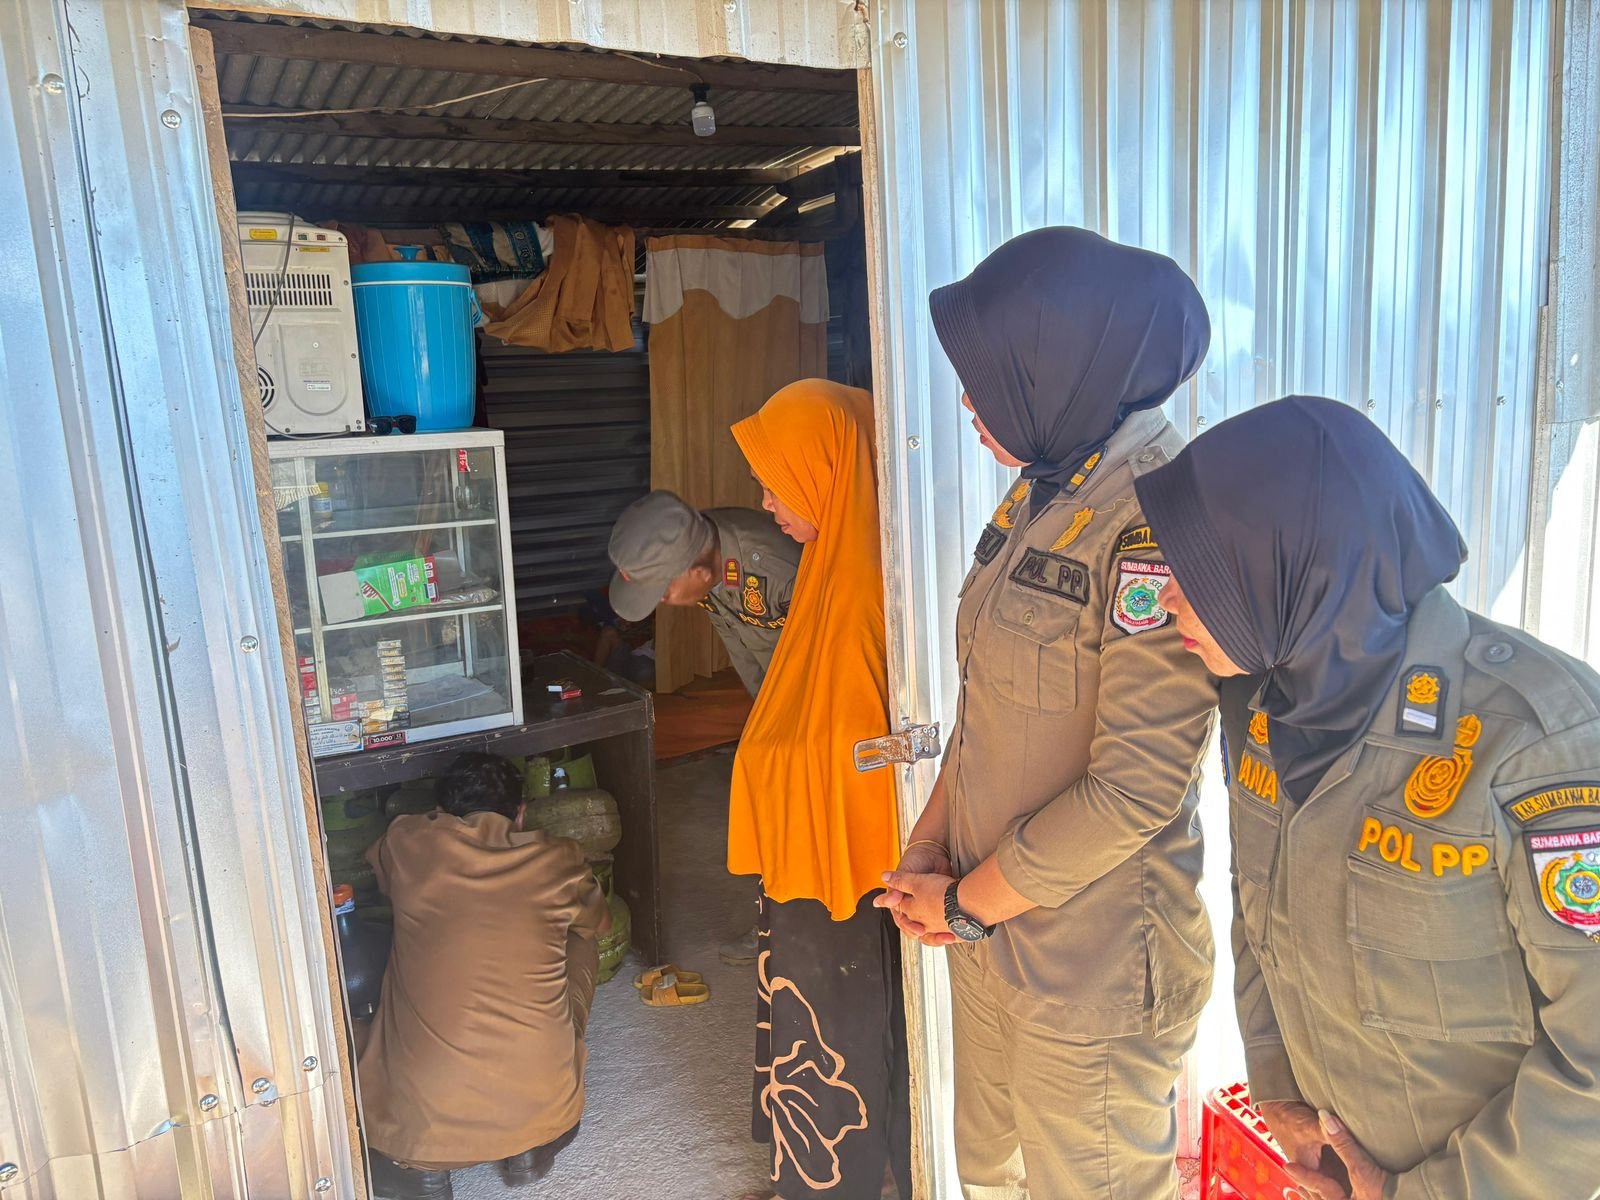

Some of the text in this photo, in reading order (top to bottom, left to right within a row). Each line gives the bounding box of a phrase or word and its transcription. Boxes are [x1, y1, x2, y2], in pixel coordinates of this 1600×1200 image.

[1018, 556, 1083, 593] POL PP
[1120, 561, 1151, 573] SUMBAWA
[1359, 816, 1489, 877] POL PP
[1531, 834, 1583, 849] SUMBAWA
